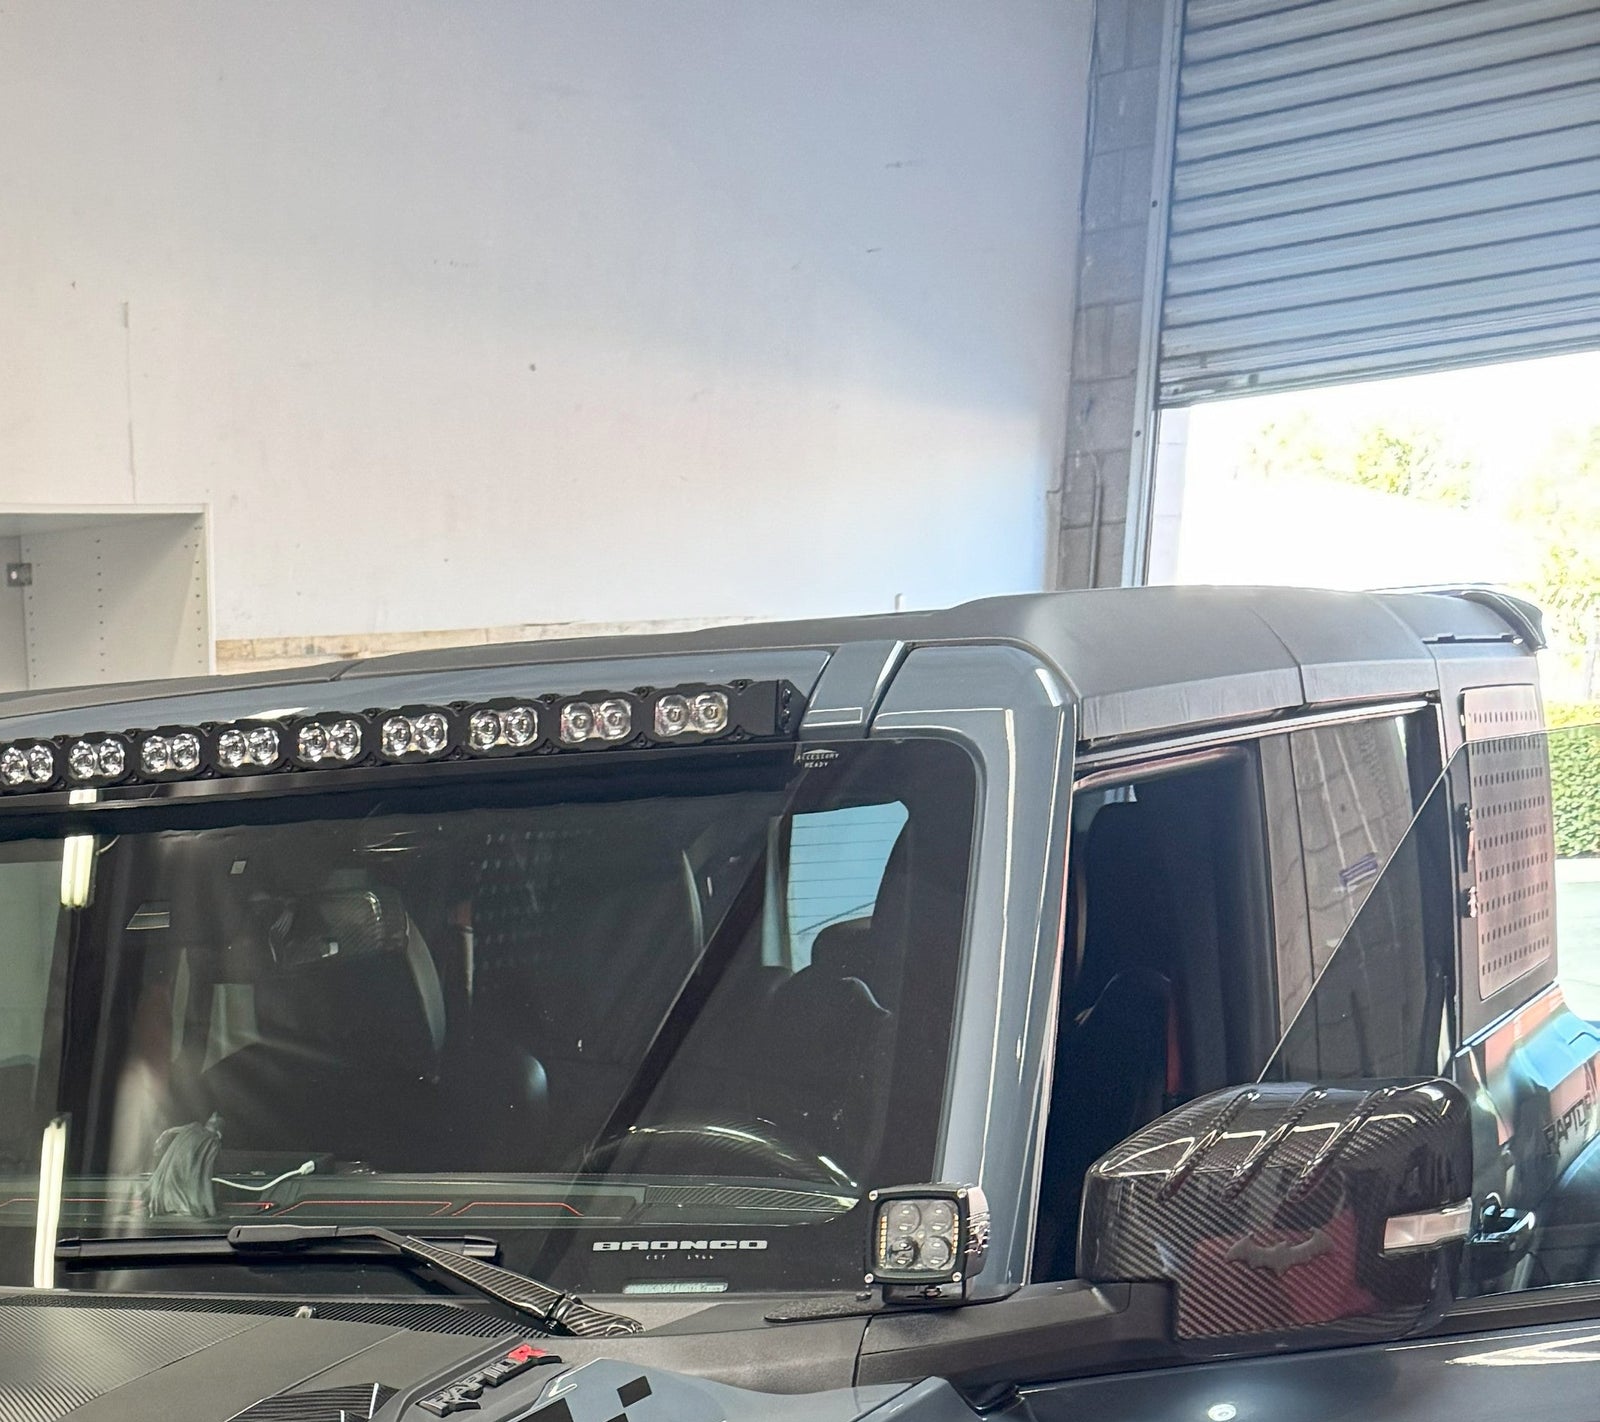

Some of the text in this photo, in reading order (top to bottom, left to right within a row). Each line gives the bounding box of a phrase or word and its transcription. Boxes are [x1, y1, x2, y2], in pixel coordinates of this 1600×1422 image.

[796, 752, 840, 761] ACCESSORY
[592, 1240, 768, 1252] BRONCO
[418, 1343, 562, 1418] RAPTOR
